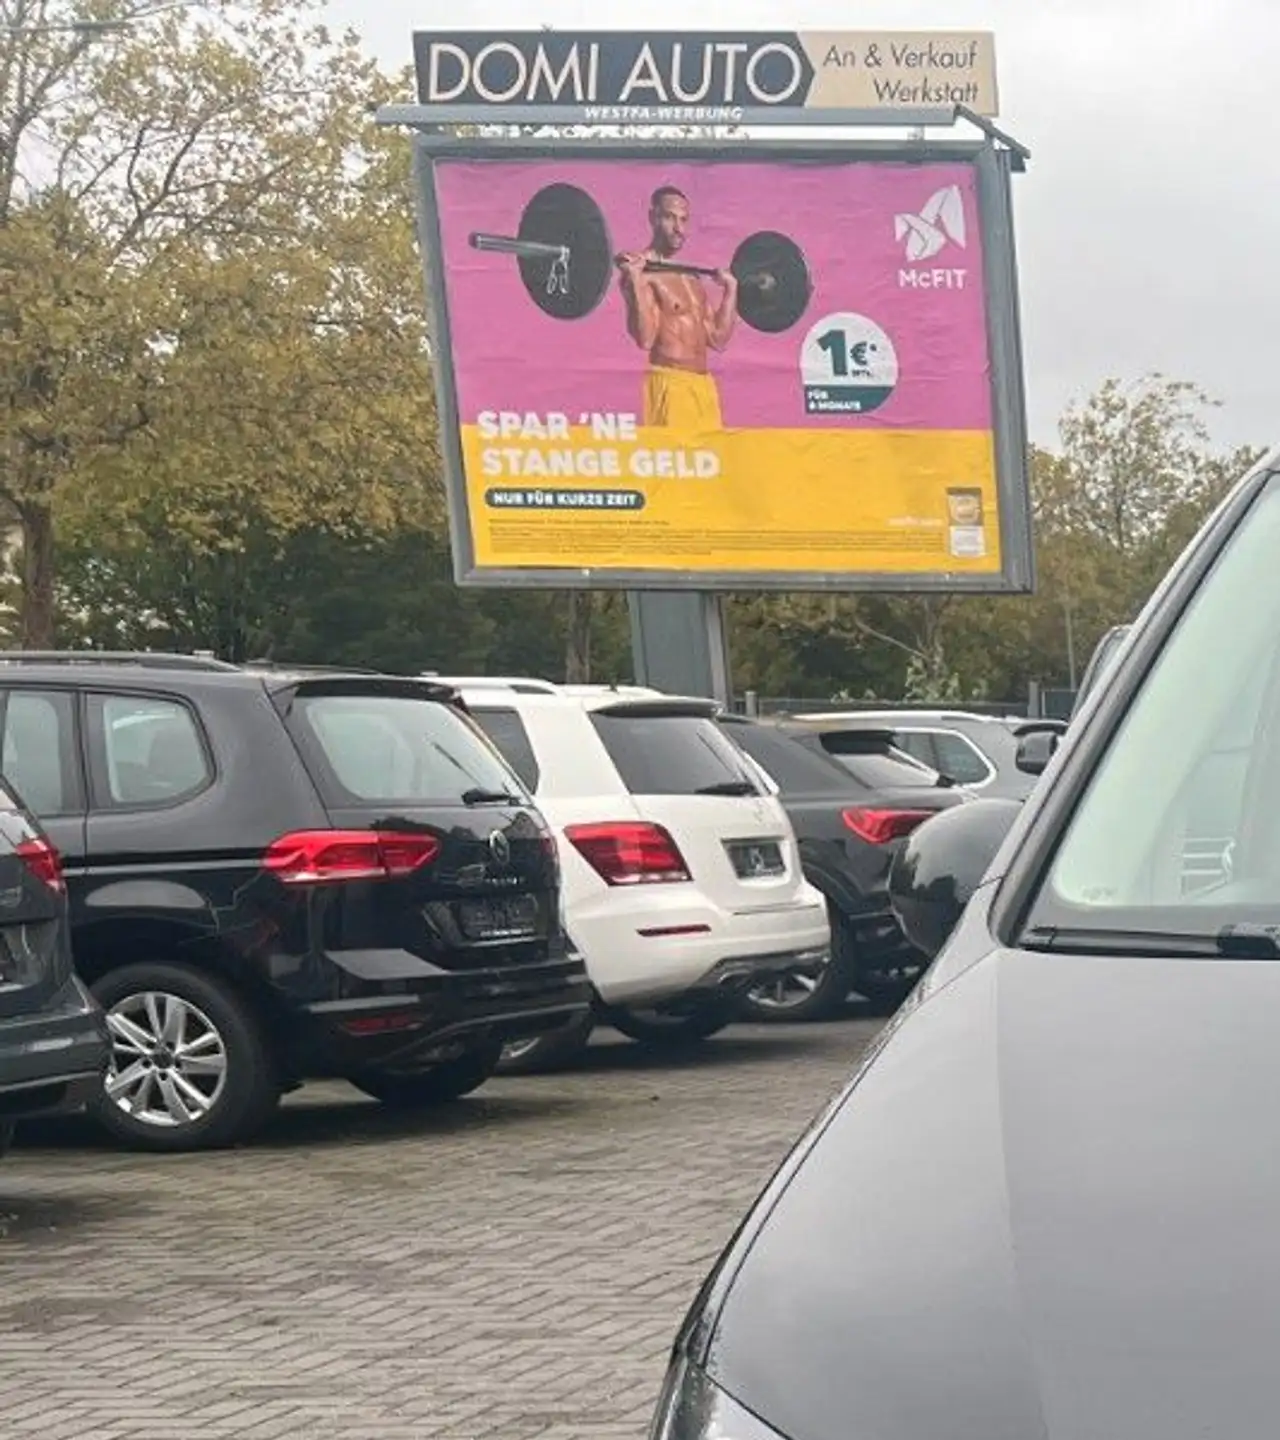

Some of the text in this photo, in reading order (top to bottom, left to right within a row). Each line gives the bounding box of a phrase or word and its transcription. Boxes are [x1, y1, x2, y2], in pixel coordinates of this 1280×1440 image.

[823, 41, 978, 68] An & Verkauf
[429, 41, 803, 103] DOMI AUTO
[873, 77, 979, 103] Werkstatt
[899, 269, 967, 289] McFIT
[477, 411, 570, 440] SPAR
[482, 447, 721, 478] STANGE GELD
[493, 490, 638, 506] NUR FÜR KURZE ZEIT
